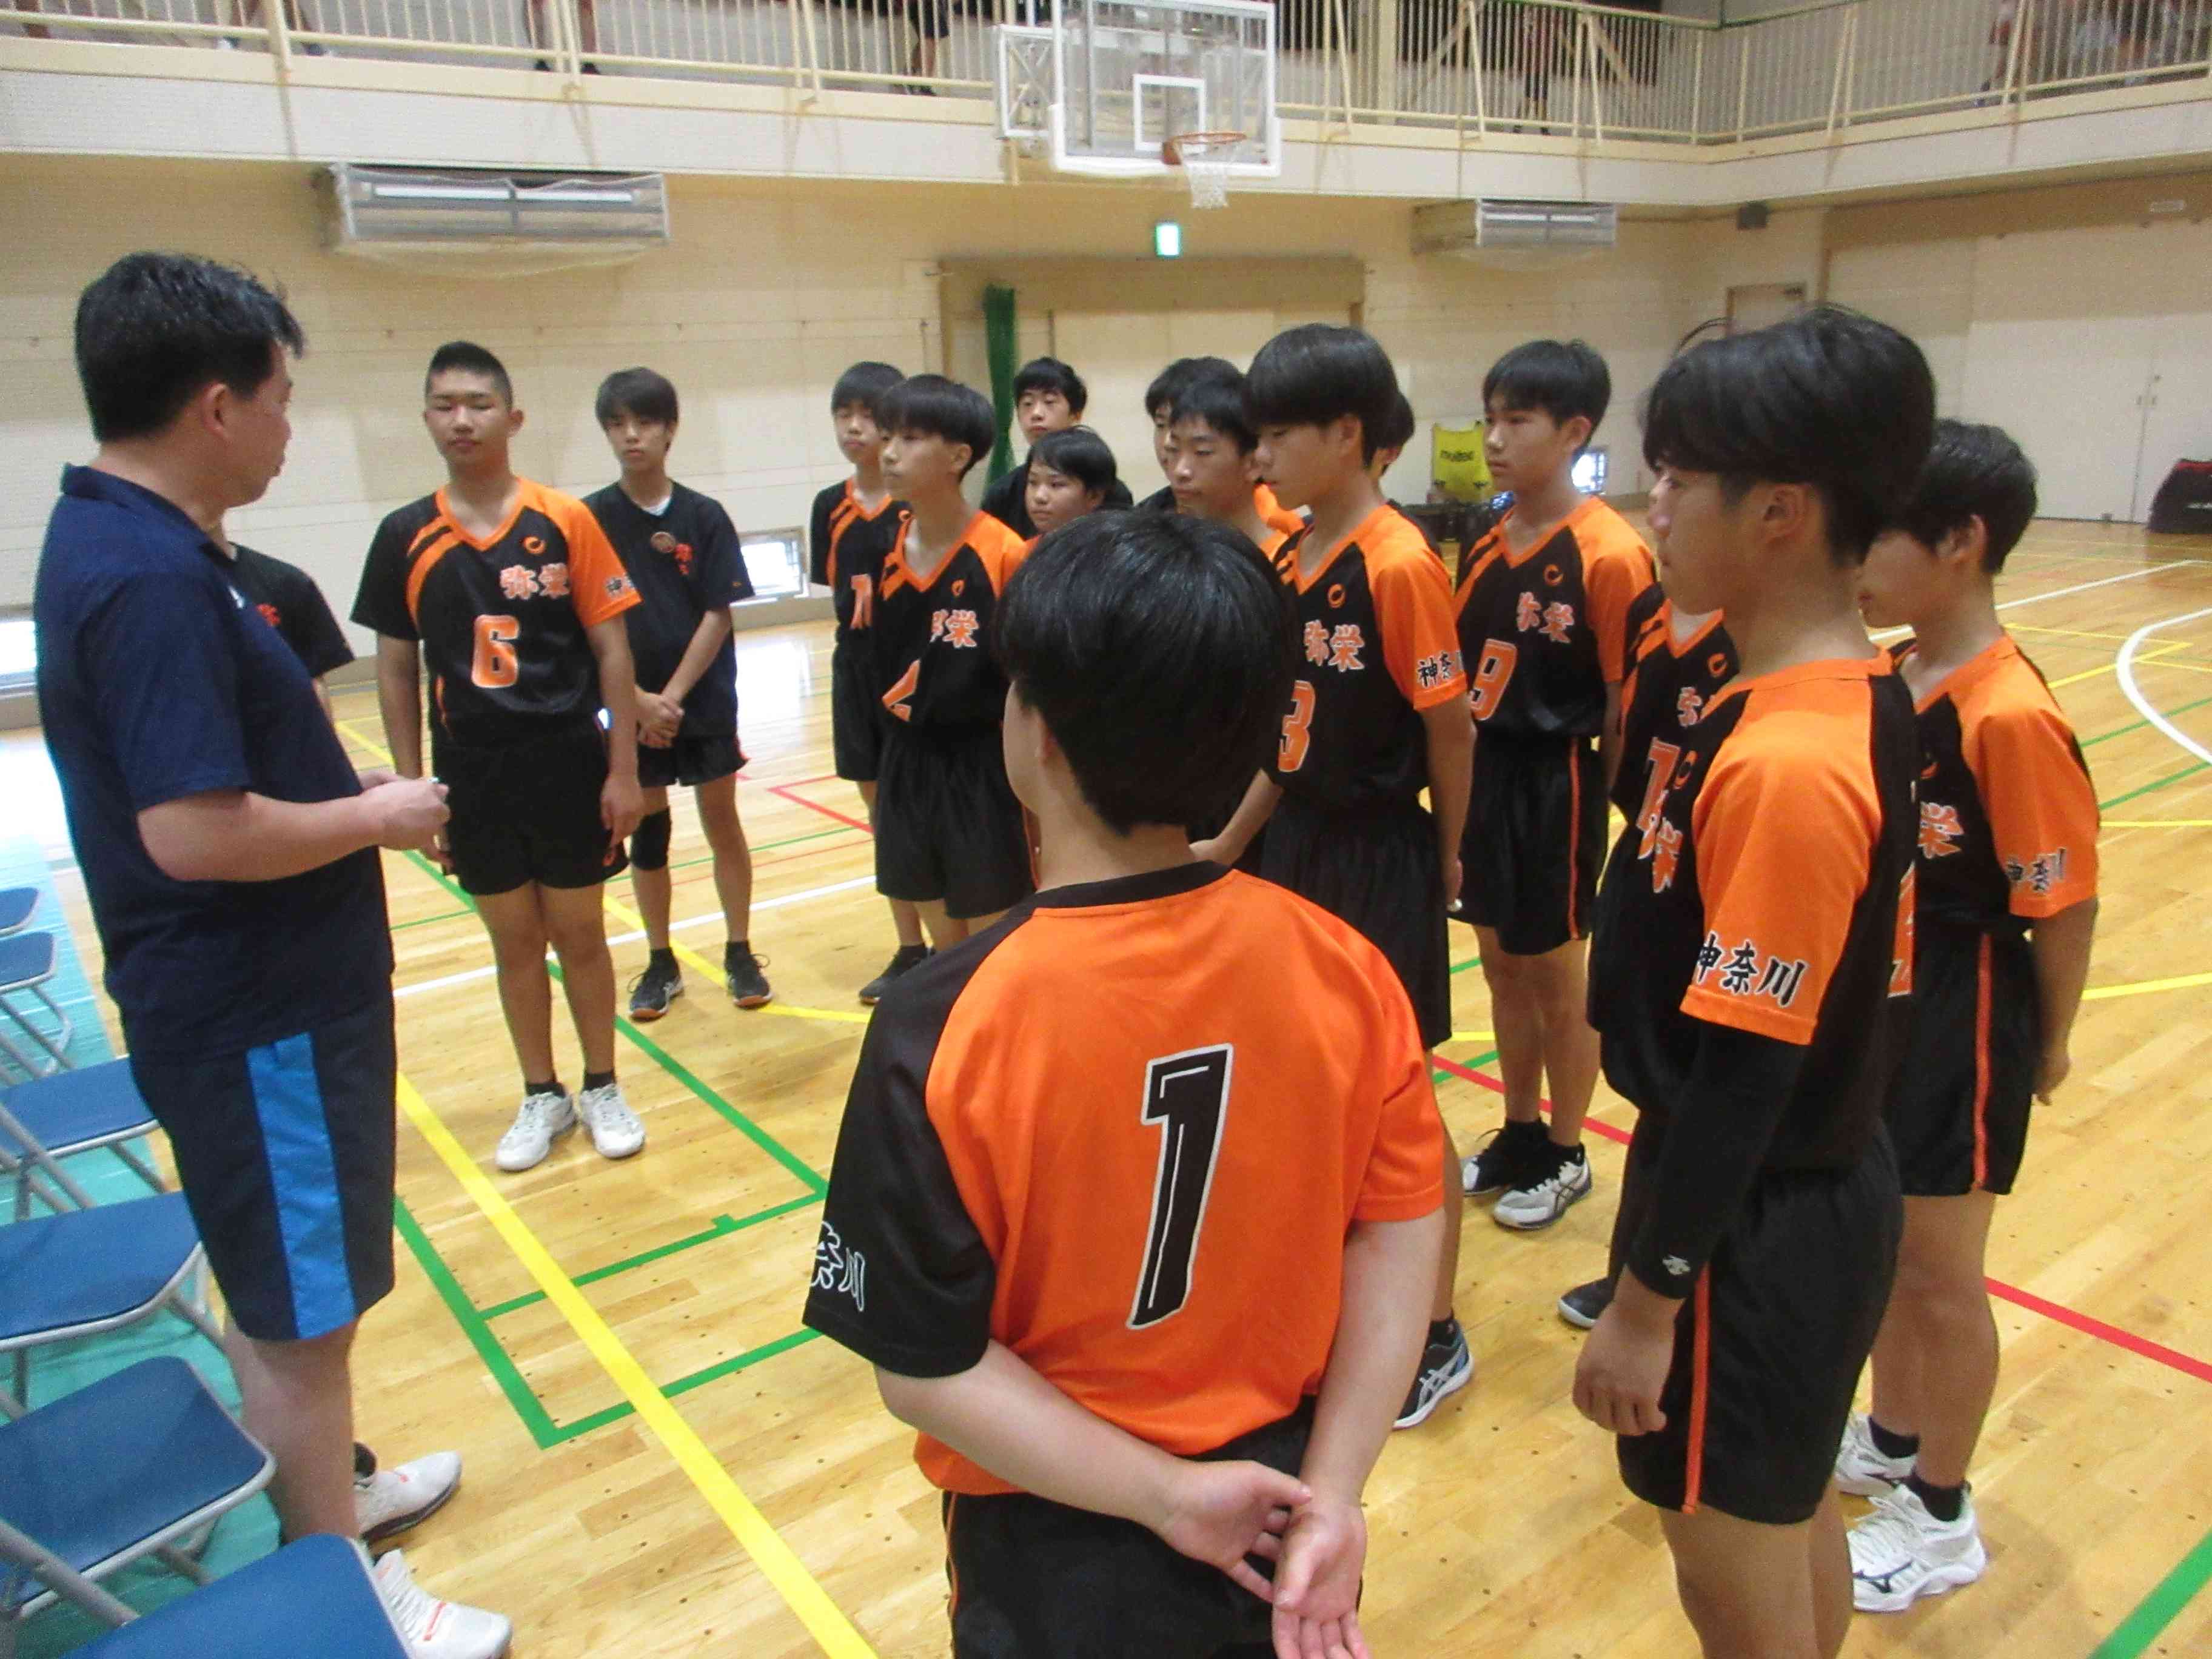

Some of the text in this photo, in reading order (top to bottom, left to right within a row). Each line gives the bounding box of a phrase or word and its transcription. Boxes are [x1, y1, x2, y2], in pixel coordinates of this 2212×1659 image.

[471, 614, 520, 688] 6
[1469, 638, 1518, 722] 9
[1278, 680, 1316, 773] 3
[1126, 1042, 1234, 1330] 1
